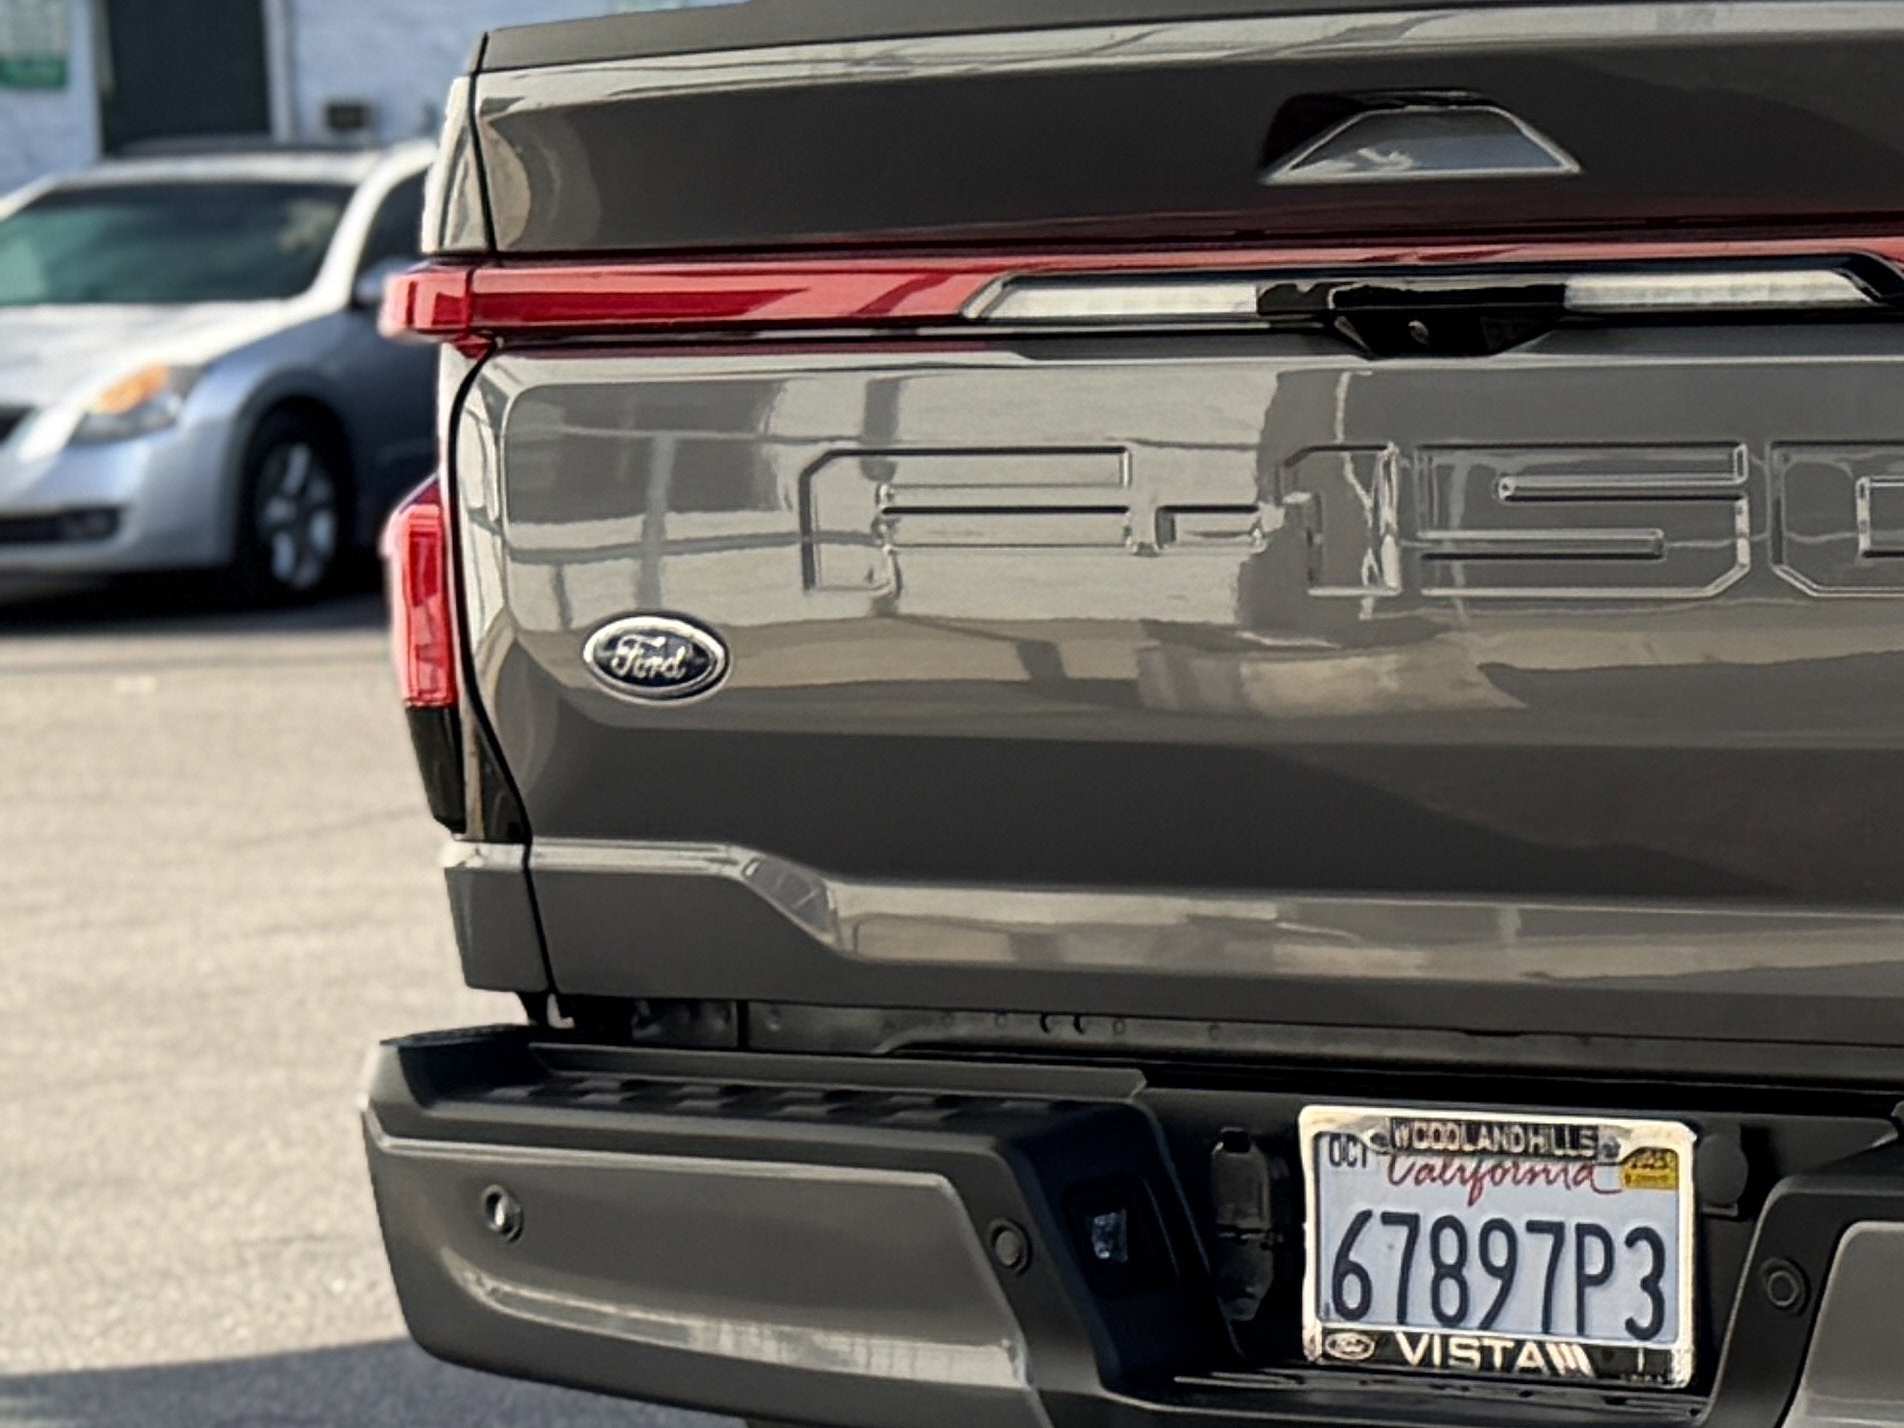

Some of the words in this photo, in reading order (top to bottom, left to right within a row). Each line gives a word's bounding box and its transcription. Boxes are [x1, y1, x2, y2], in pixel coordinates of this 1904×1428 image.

[609, 633, 692, 680] Ford
[1386, 1153, 1622, 1208] California
[1331, 1209, 1667, 1342] 67897P3
[1394, 1330, 1551, 1375] VISTA
